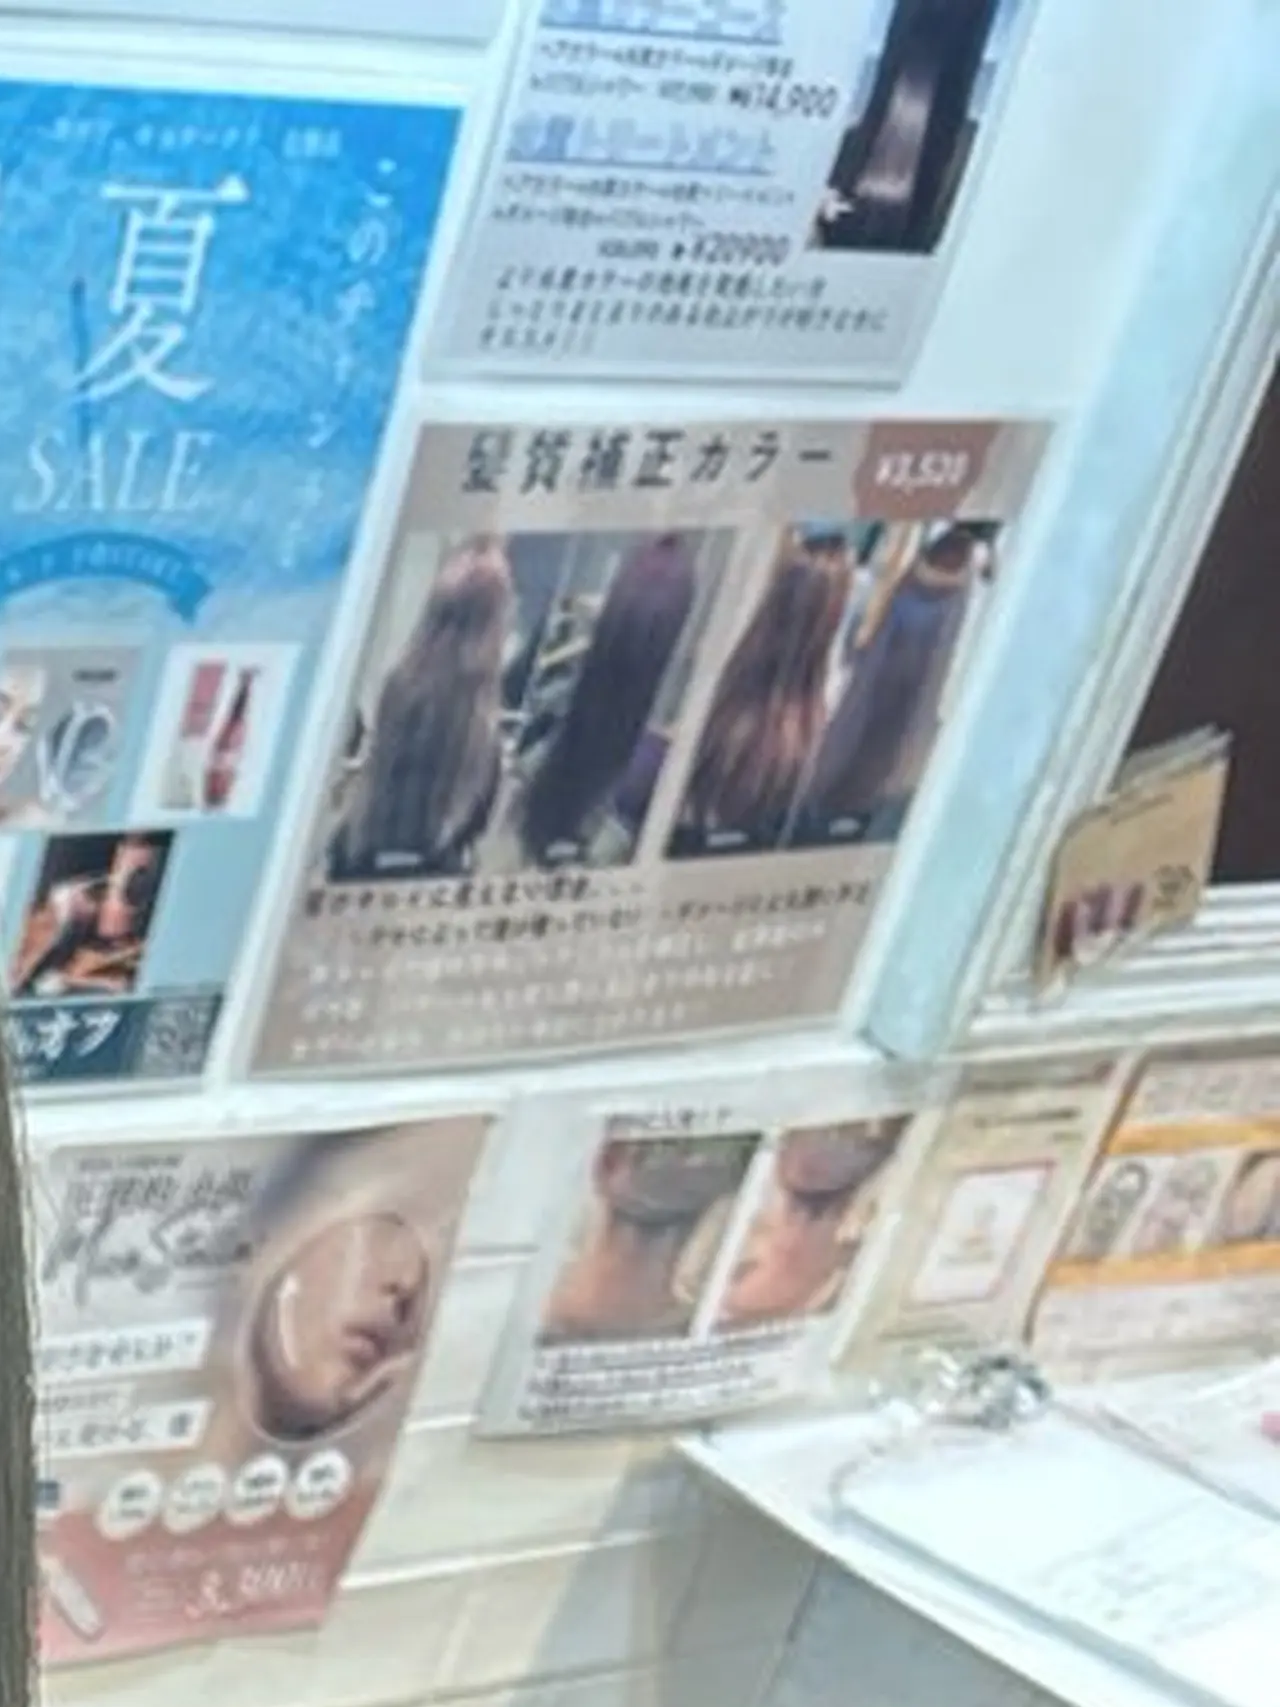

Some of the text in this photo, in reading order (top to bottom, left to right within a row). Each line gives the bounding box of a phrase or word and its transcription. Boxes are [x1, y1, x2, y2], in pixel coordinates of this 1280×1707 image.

[71, 172, 251, 402] 夏
[14, 427, 220, 513] SALE
[460, 428, 833, 495] 髪質補正カラー
[874, 450, 970, 492] ¥3,520
